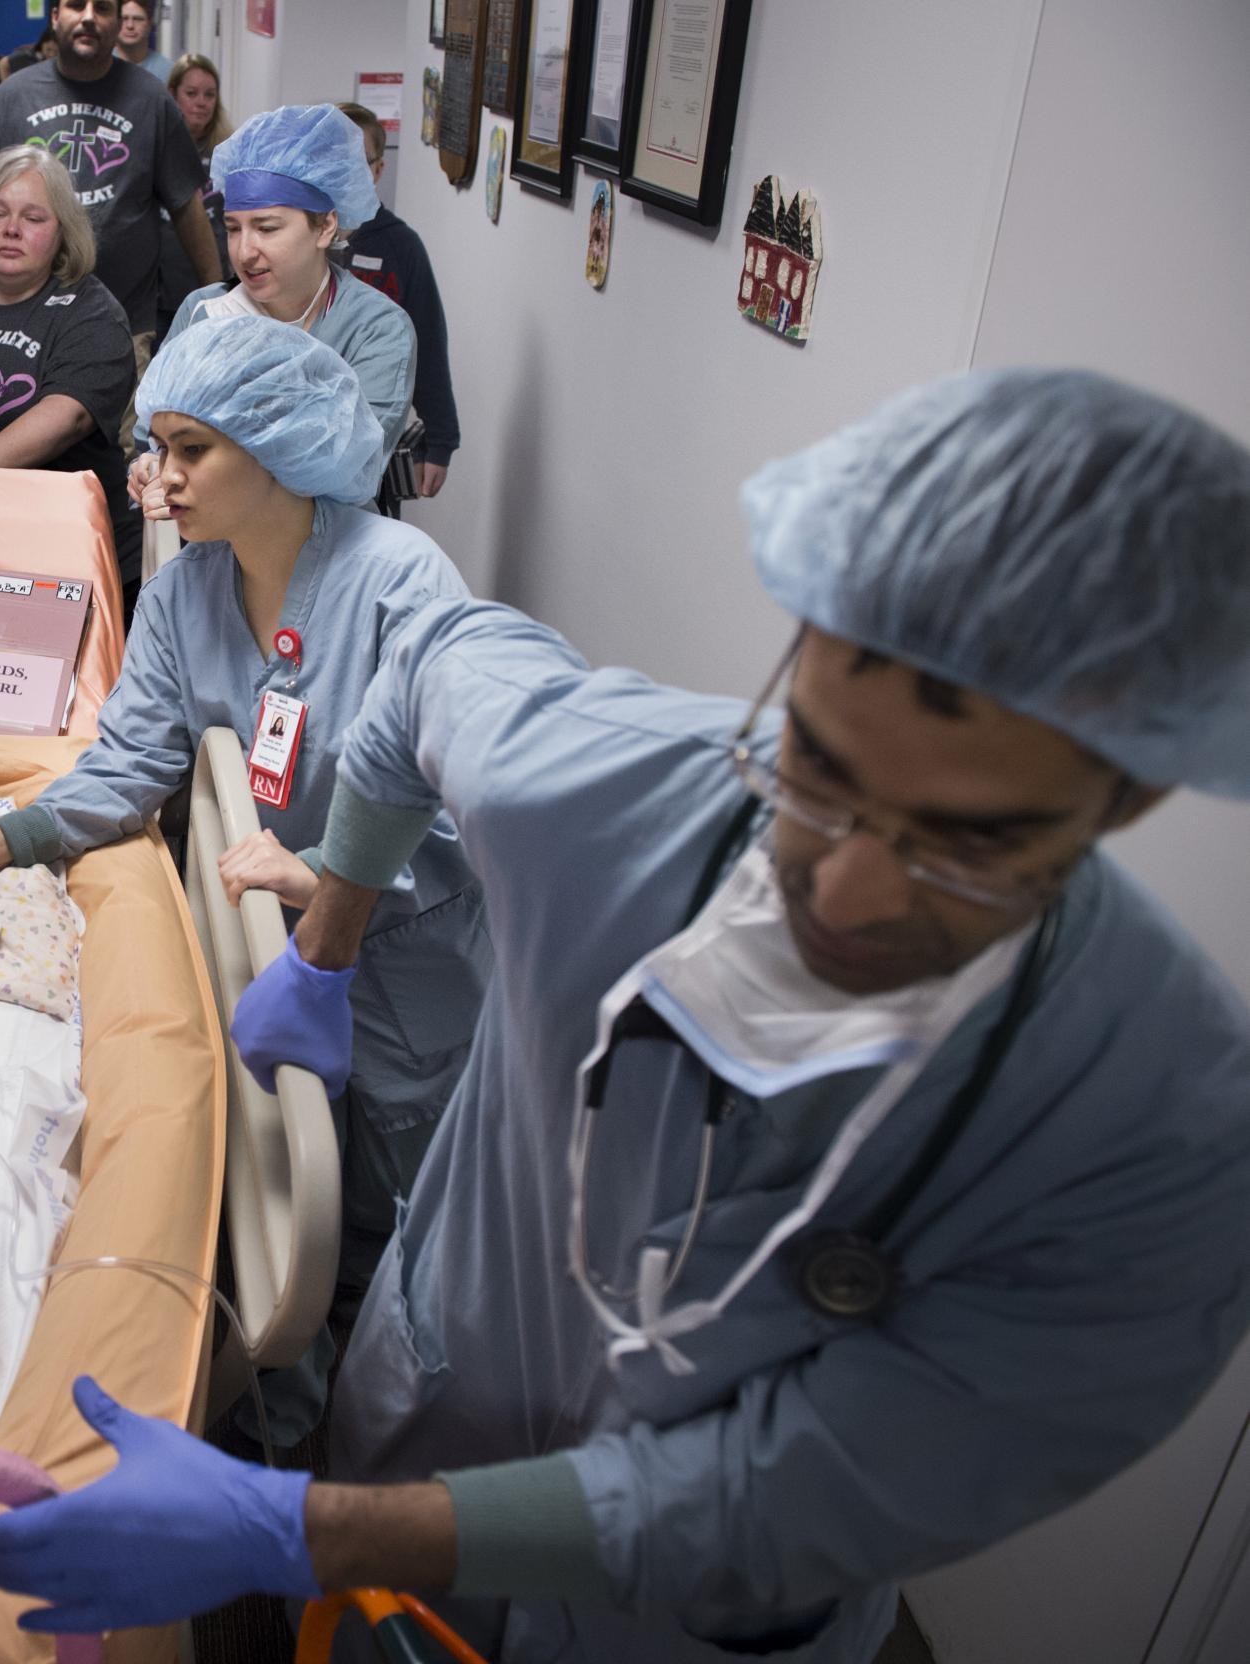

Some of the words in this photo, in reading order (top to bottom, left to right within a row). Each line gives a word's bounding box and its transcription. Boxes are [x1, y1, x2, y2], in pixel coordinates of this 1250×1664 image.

[26, 103, 68, 127] TWO
[71, 102, 134, 134] HEARTS
[253, 774, 278, 798] RN
